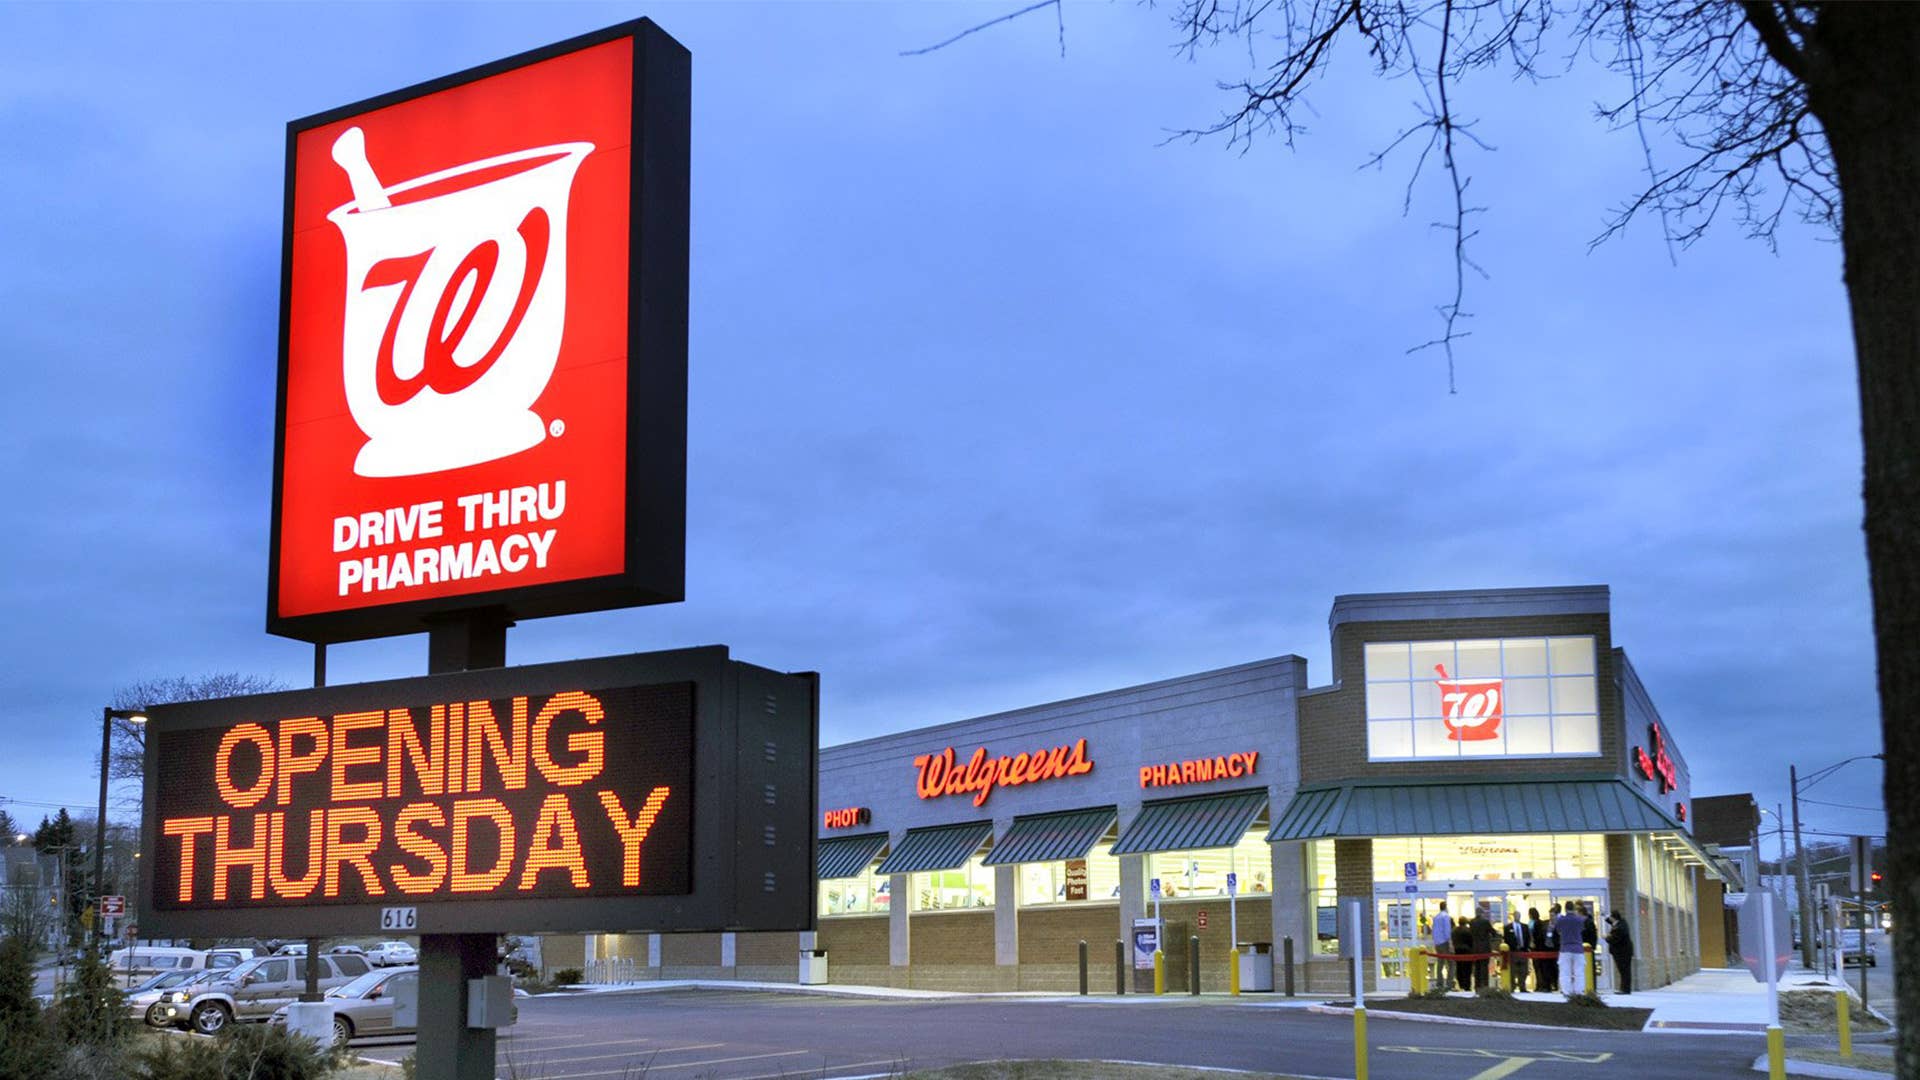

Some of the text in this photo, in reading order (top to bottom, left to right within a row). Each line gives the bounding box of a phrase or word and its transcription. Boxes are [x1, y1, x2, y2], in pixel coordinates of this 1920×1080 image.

[333, 479, 567, 553] DRIVE THRU
[338, 528, 557, 597] PHARMACY
[215, 690, 606, 808] OPENING
[912, 738, 1093, 807] Walgreens
[1138, 751, 1258, 789] PHARMACY
[164, 786, 670, 902] THURSDAY
[384, 909, 415, 928] 616
